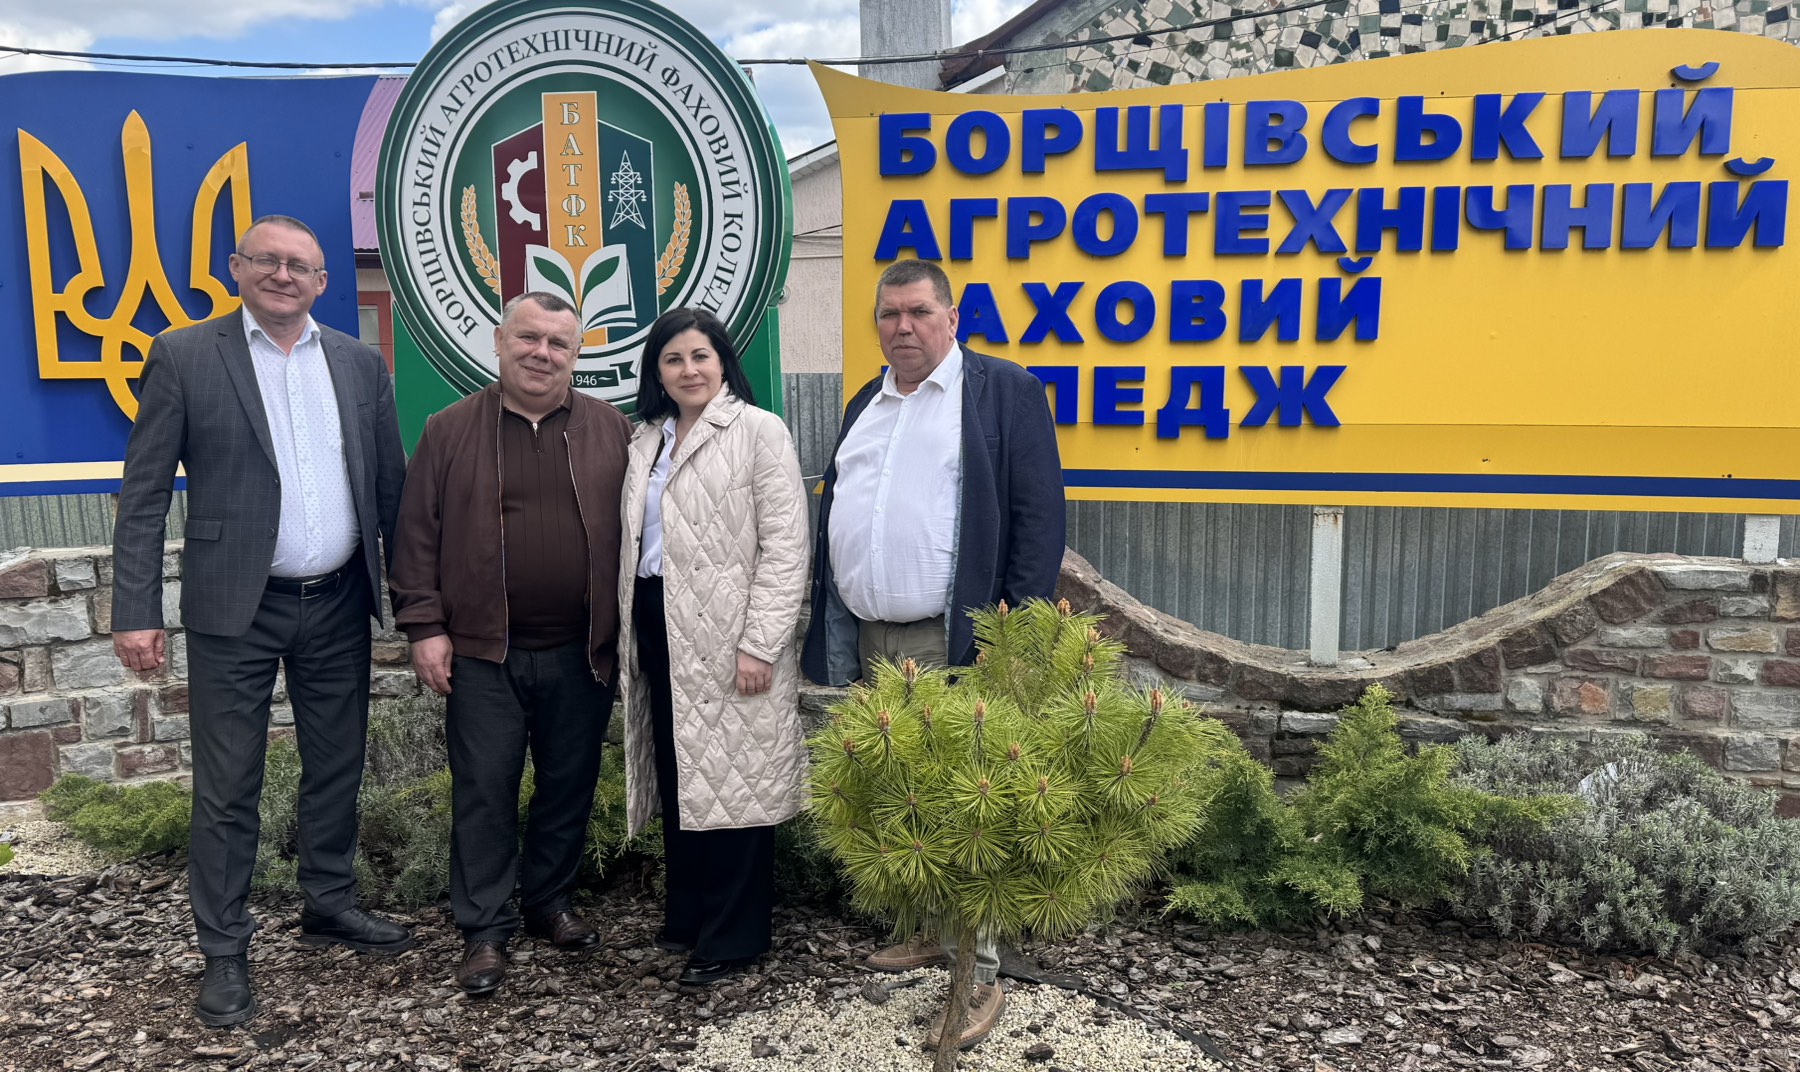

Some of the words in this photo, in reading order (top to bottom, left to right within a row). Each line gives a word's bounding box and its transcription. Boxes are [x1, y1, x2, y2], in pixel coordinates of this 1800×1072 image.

[440, 28, 660, 125] АГРОТЕХНІЧНИЙ
[879, 63, 1733, 181] БОРЩІВСЬКИЙ
[661, 65, 748, 202] ФАХОВИЙ
[412, 123, 479, 338] БОРЩІВСЬКИЙ
[874, 159, 1788, 260] АГРОТЕХНІЧНИЙ
[695, 210, 743, 314] КОЛЕД
[874, 257, 1382, 343] АХОВИЙ
[571, 374, 597, 386] 1946
